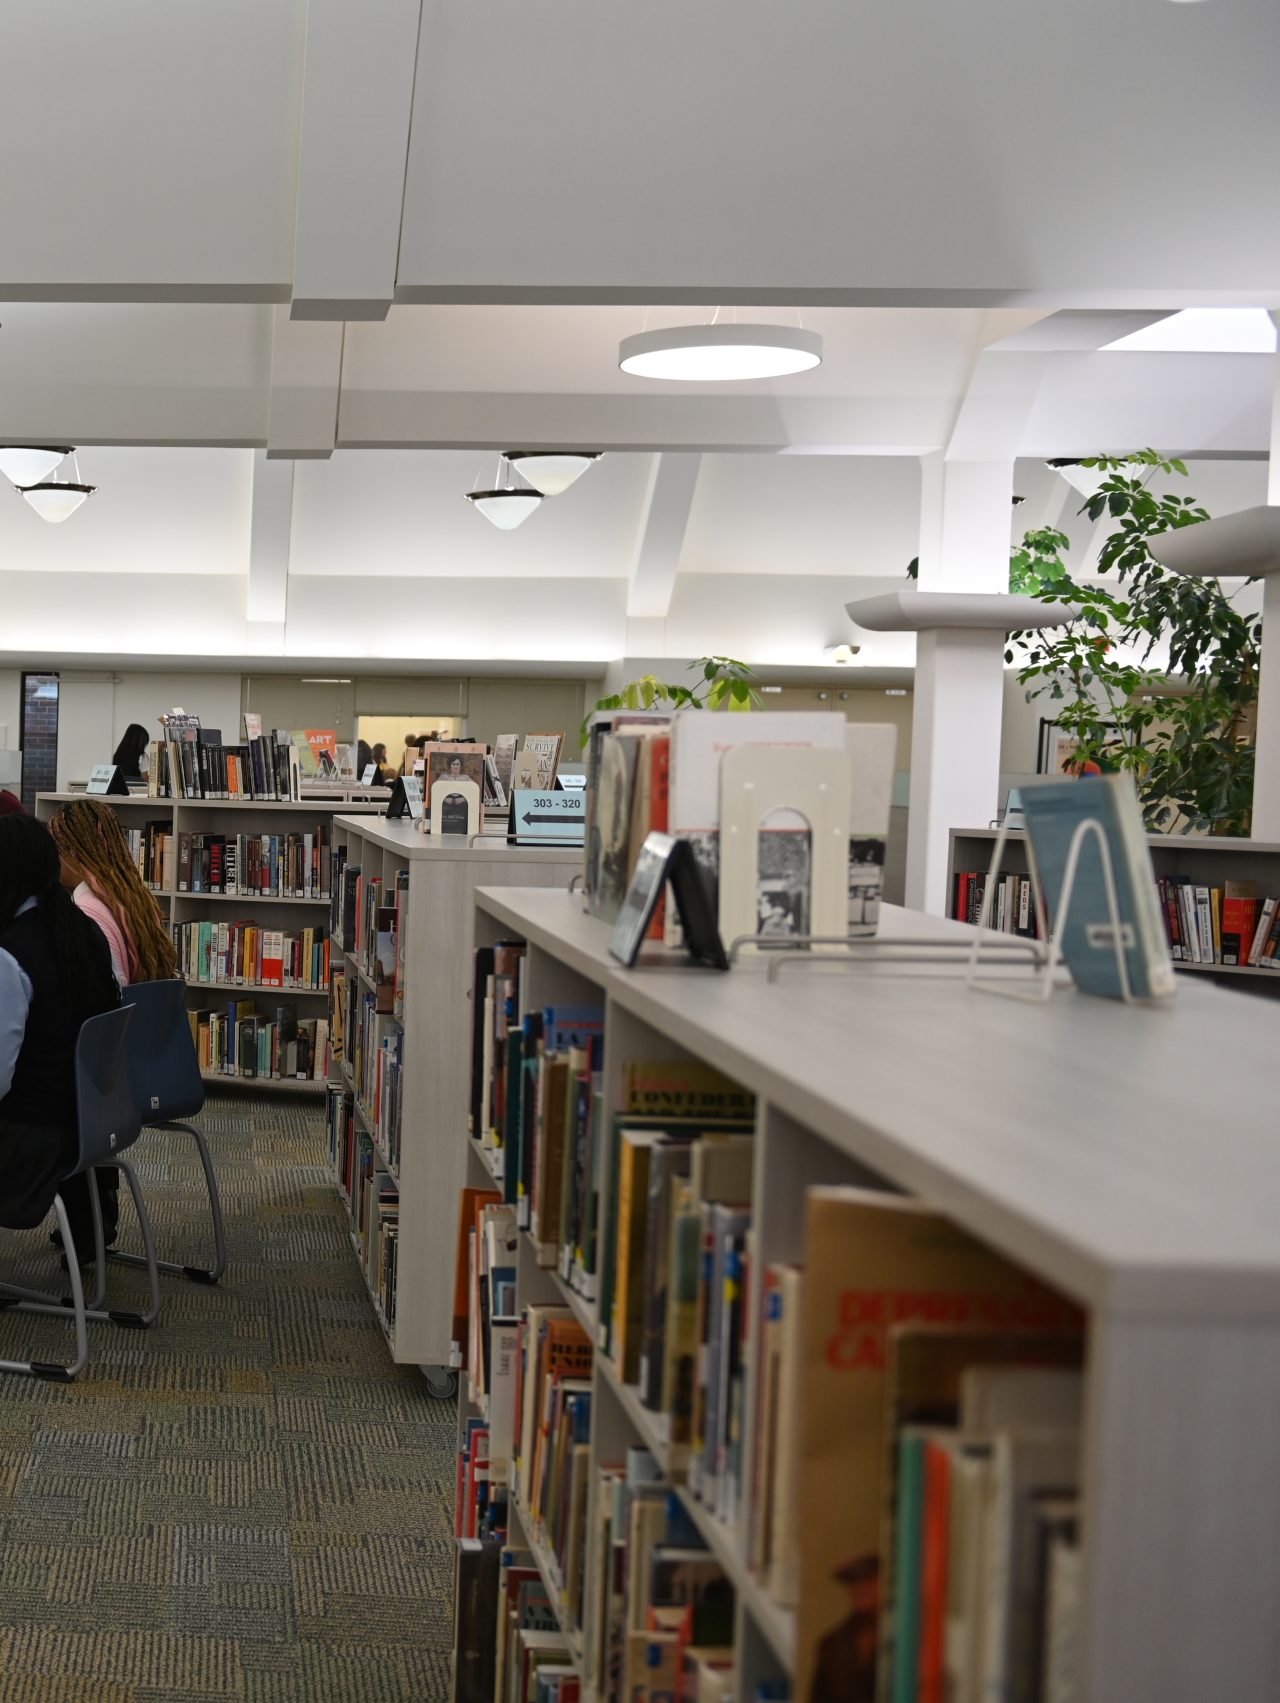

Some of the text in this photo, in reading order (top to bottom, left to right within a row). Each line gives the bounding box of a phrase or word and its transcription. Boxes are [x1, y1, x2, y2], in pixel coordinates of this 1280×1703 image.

[308, 735, 333, 745] ART
[533, 798, 552, 808] 303
[562, 798, 581, 809] 320
[211, 845, 221, 886] HITLER
[226, 847, 236, 885] HITLER
